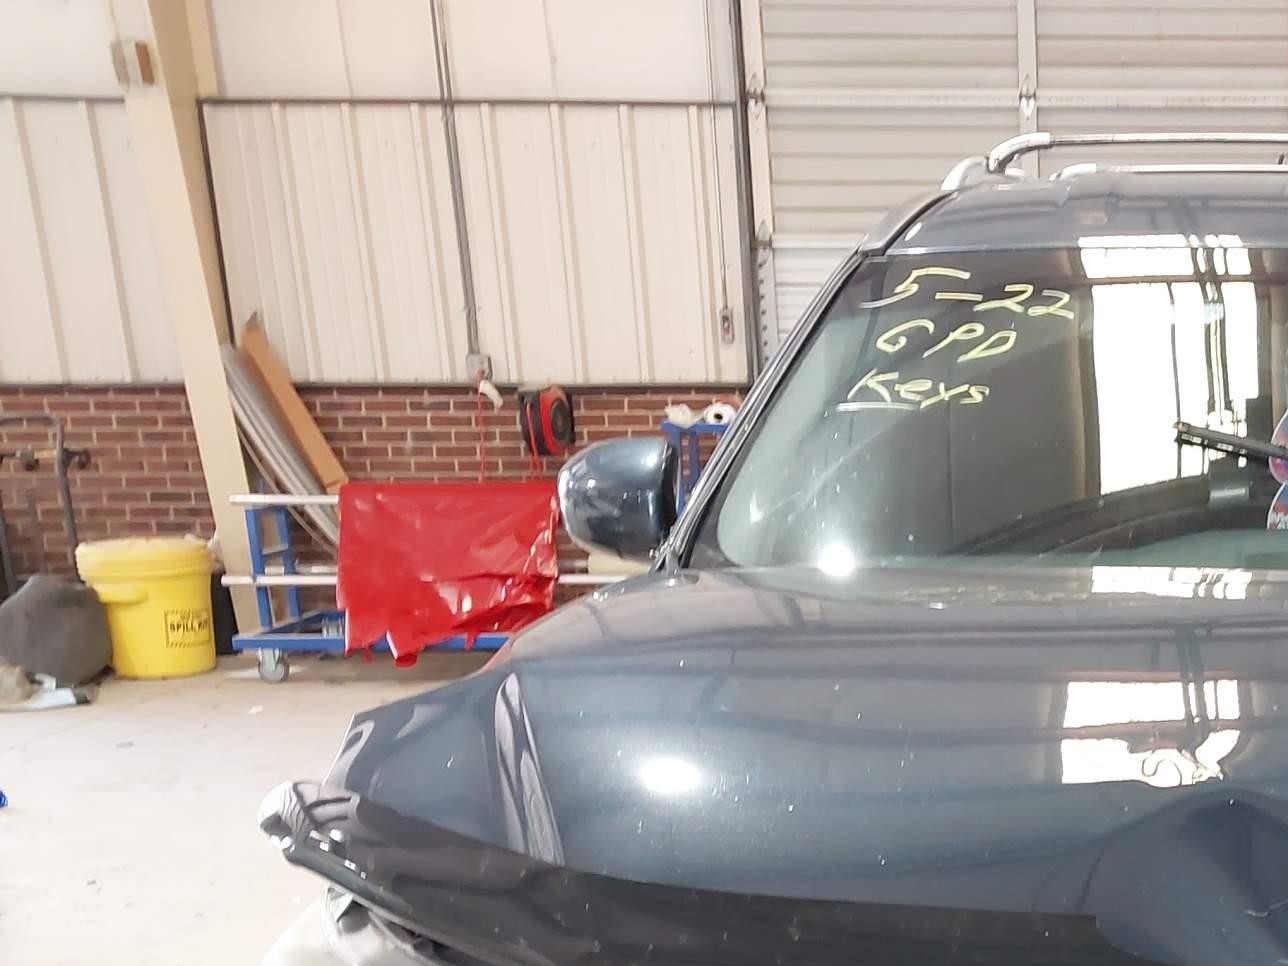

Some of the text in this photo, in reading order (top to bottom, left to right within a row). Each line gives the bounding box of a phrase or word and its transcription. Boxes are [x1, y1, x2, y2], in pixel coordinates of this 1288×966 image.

[859, 266, 1075, 320] 5-22
[846, 367, 990, 410] Keys
[170, 622, 195, 633] SPILL
